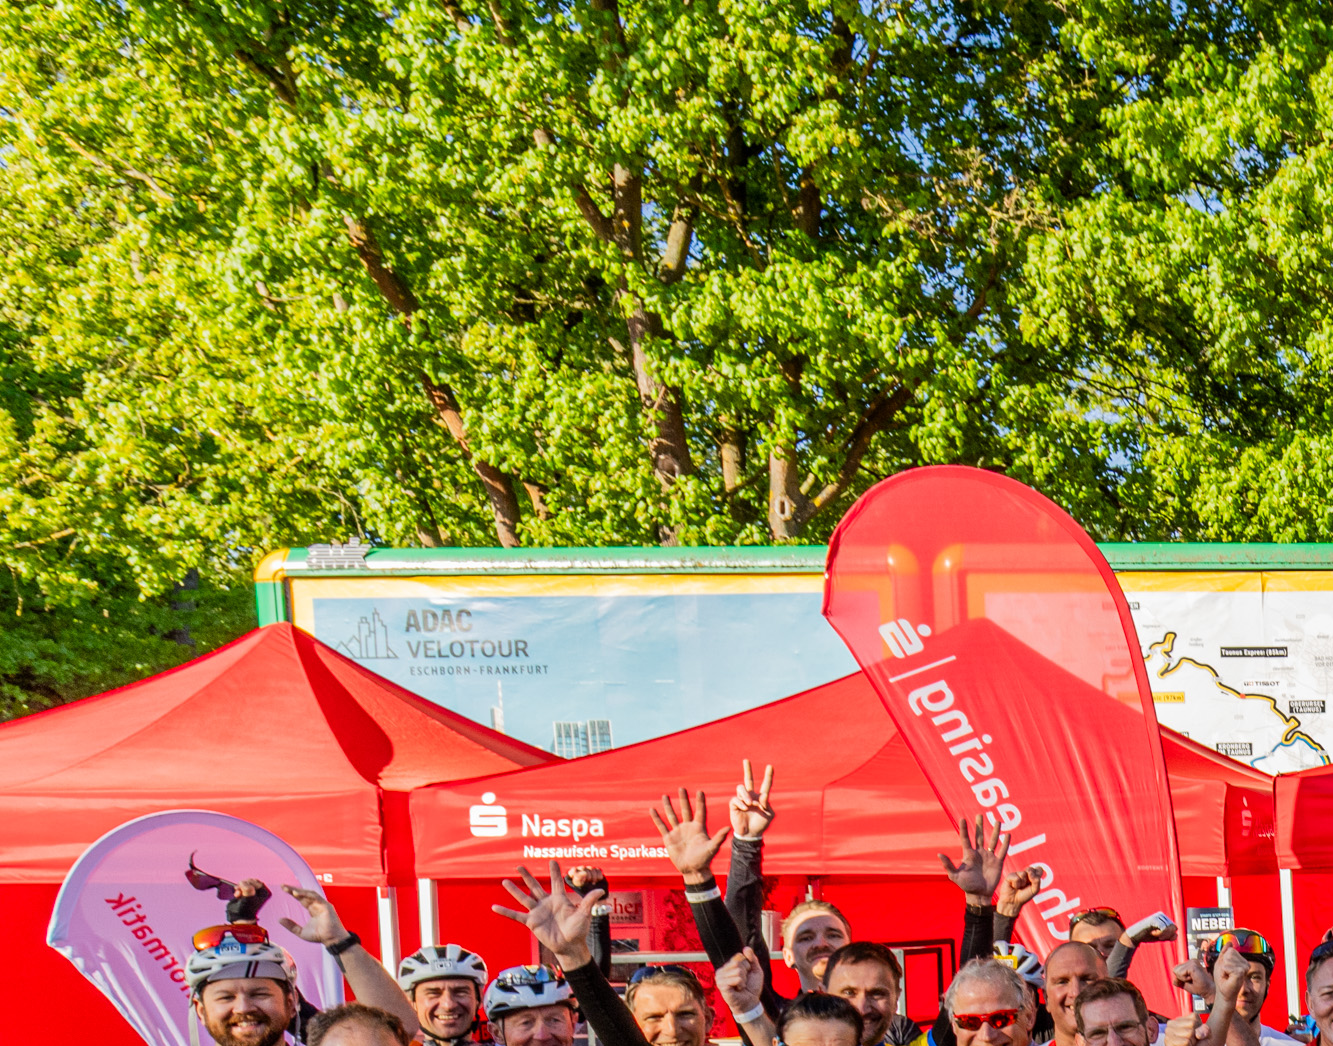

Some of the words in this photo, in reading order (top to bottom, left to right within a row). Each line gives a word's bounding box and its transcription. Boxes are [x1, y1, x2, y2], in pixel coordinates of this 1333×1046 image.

[405, 609, 472, 632] ADAC
[407, 640, 529, 658] VELOTOUR
[521, 813, 604, 841] Naspa
[523, 844, 607, 859] Nassauische
[609, 844, 670, 861] Sparkass
